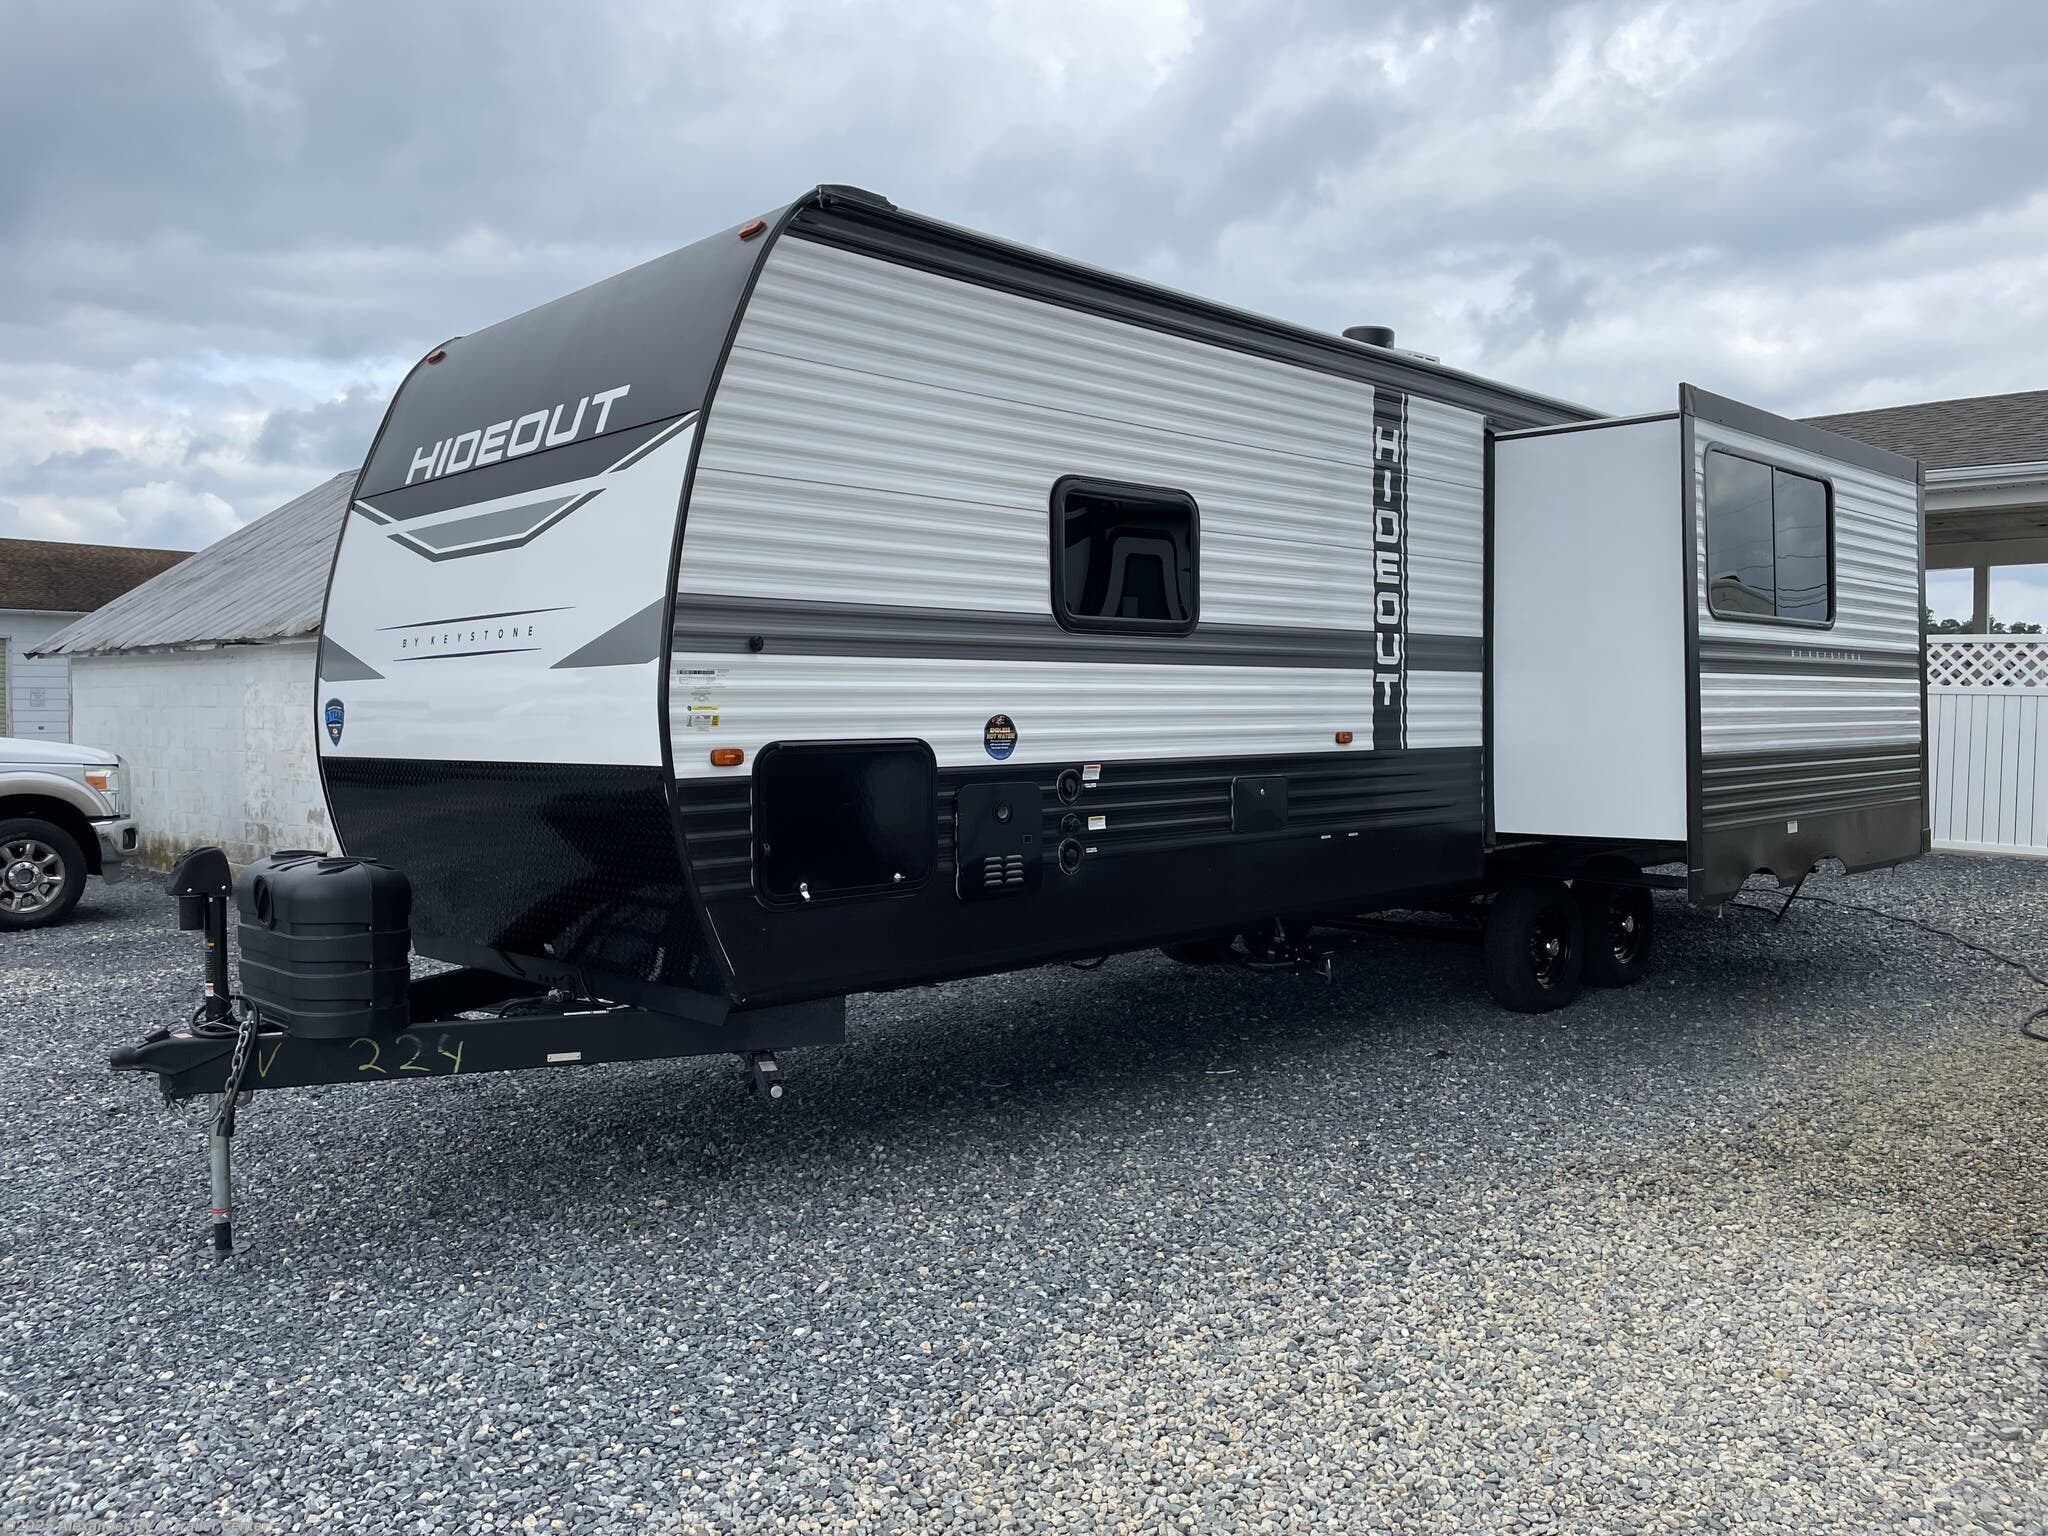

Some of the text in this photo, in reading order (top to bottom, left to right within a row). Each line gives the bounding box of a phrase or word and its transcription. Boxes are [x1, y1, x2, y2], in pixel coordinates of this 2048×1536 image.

[405, 384, 631, 485] HIDEOUT
[1375, 425, 1401, 707] HIDEOUT
[401, 625, 534, 648] BY KEYSTONE
